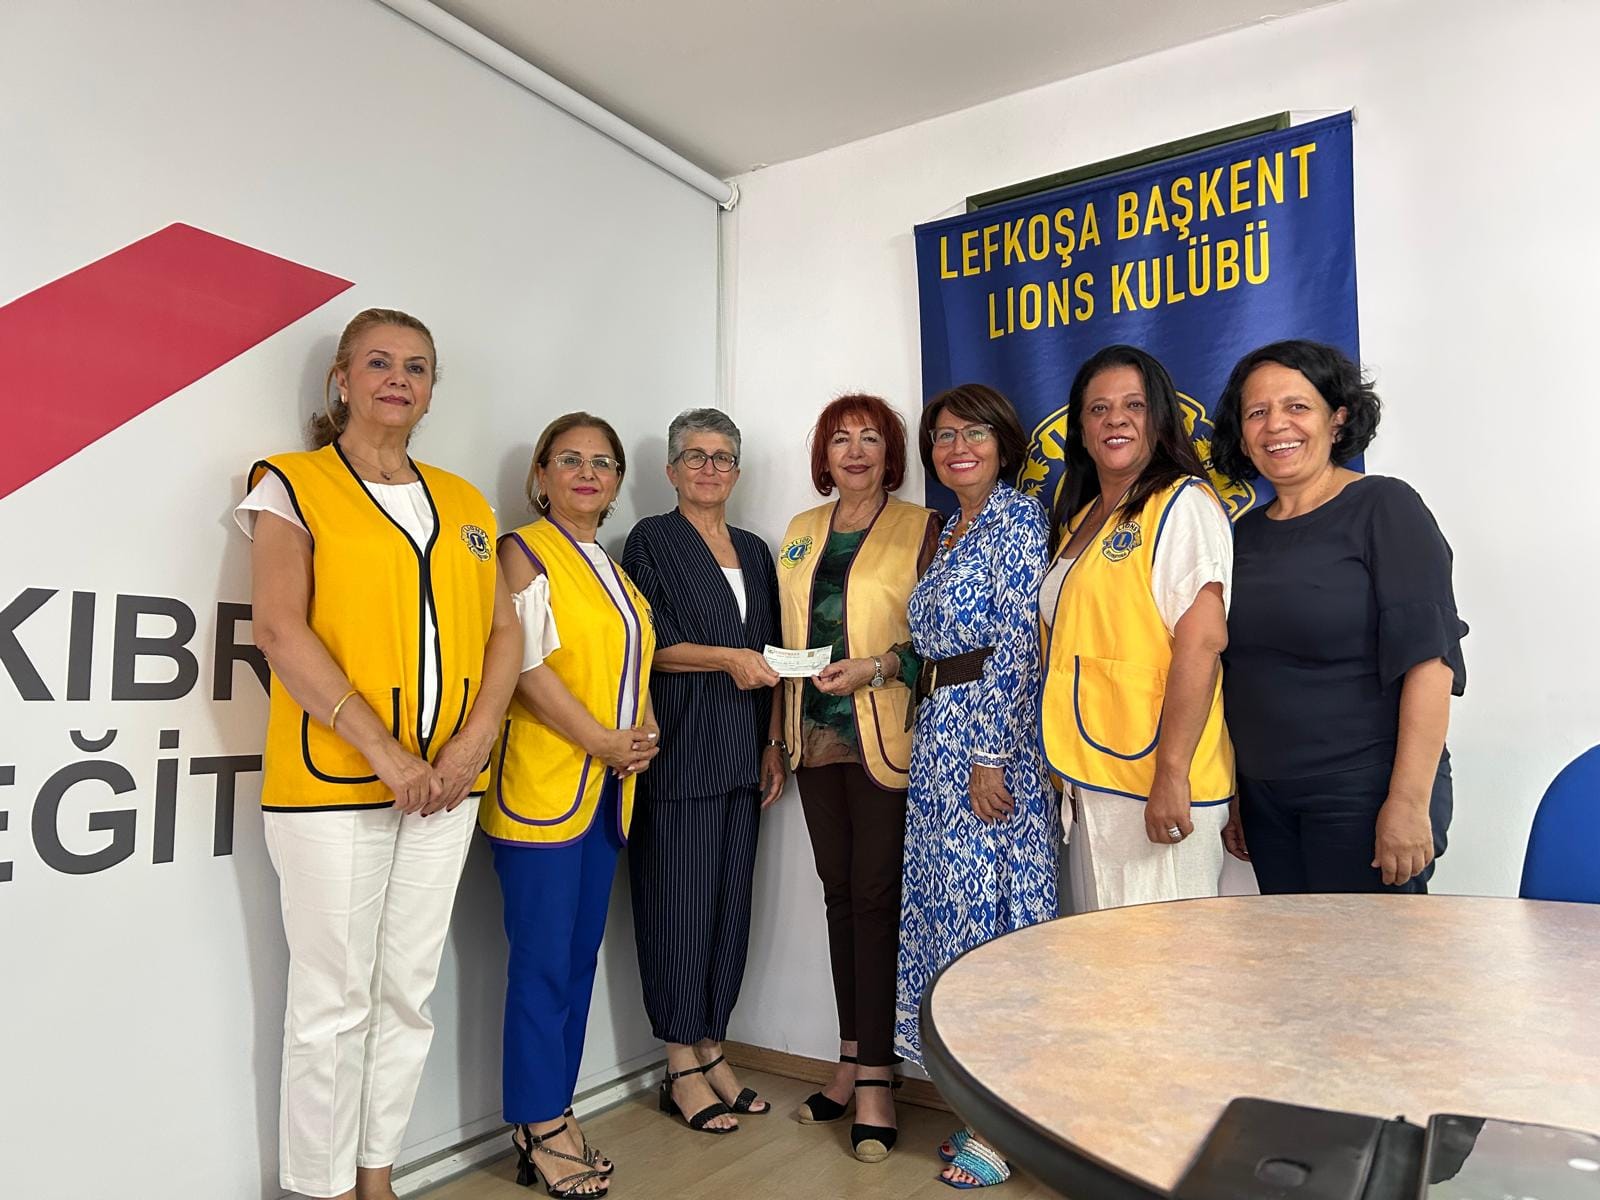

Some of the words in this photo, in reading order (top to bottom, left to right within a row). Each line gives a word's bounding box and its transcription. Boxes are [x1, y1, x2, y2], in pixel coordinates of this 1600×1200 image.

[939, 202, 1101, 279] LEFKOŞA
[1117, 142, 1317, 240] BAŞKENT
[987, 272, 1095, 339] LIONS
[1111, 220, 1271, 314] KULÜBÜ
[0, 729, 262, 882] ĞİT
